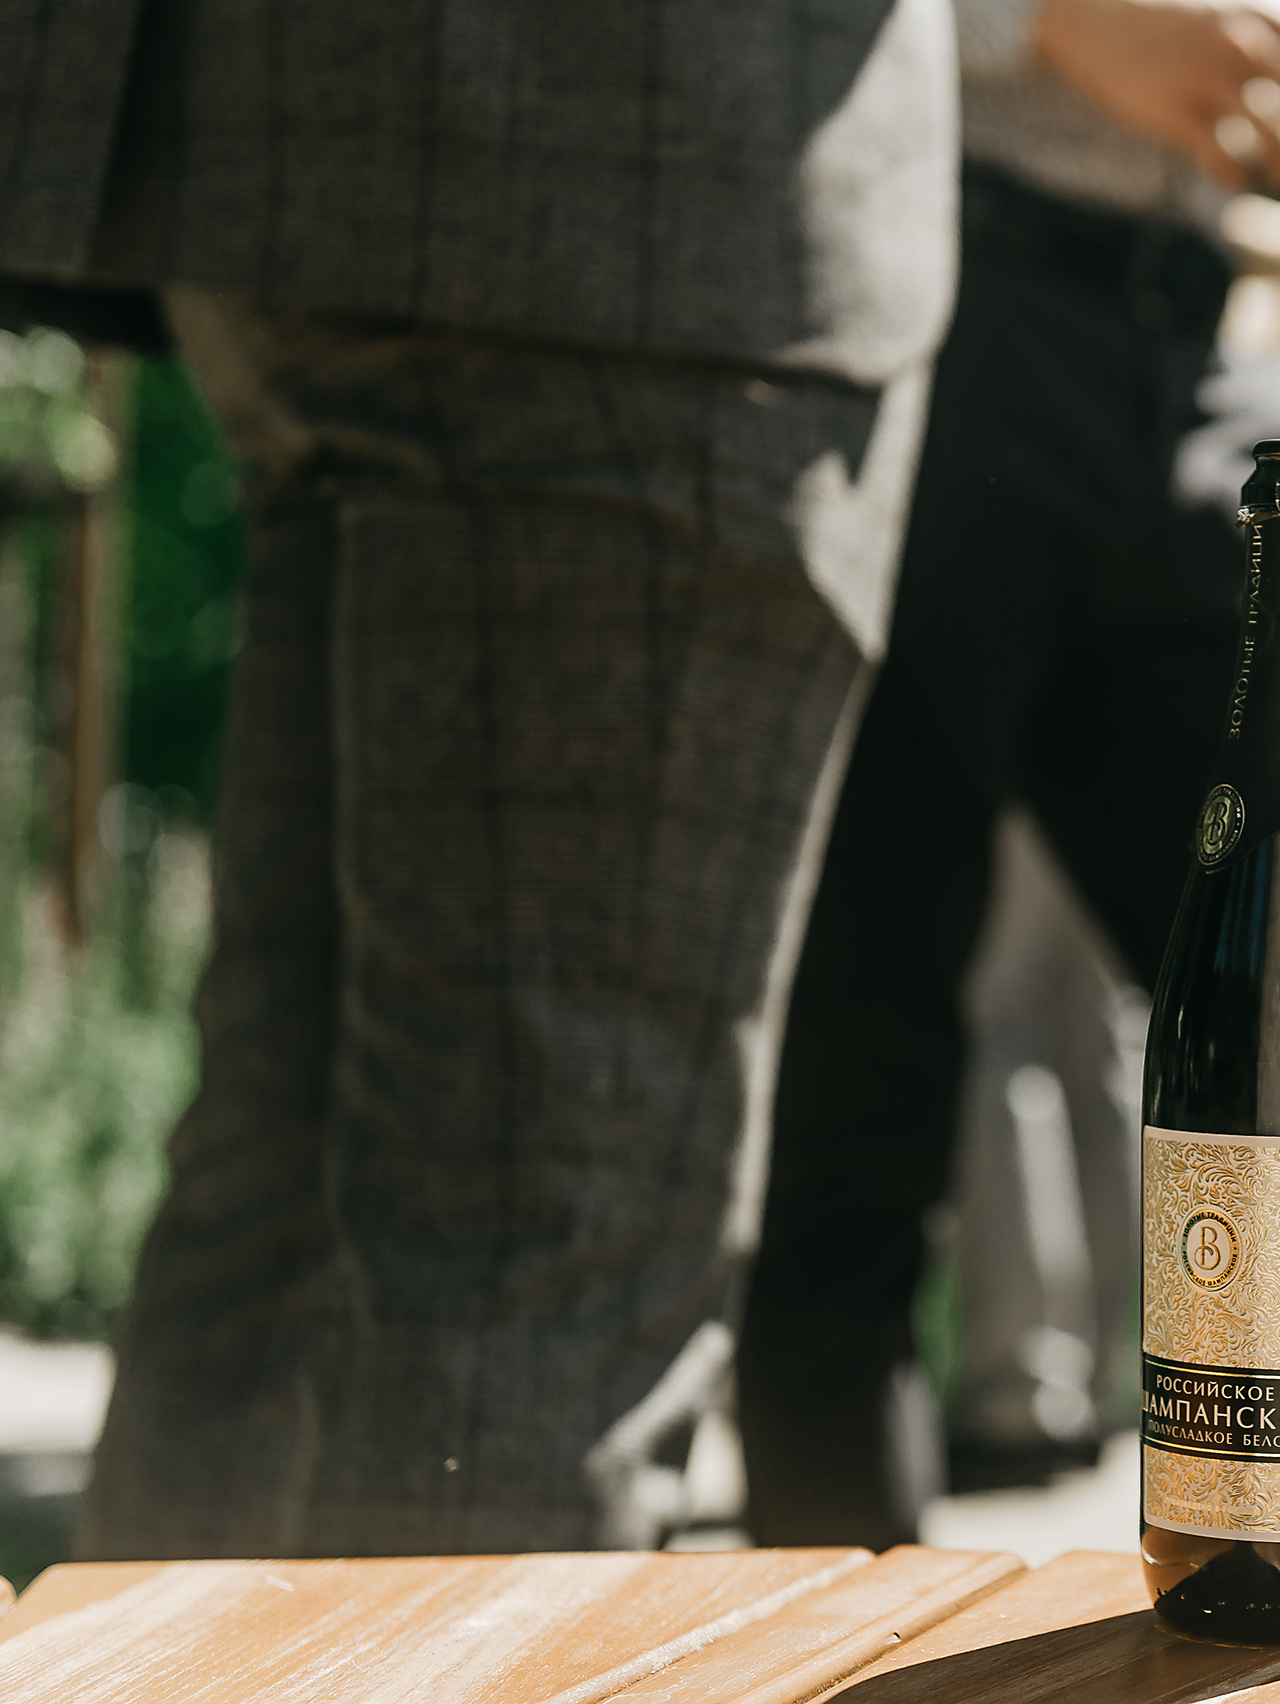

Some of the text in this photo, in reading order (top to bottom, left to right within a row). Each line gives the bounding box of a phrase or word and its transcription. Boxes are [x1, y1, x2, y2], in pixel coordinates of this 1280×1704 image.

[1229, 635, 1256, 740] ЗОЛОТЫЕ
[1207, 1211, 1238, 1243] ТРАДИЦИИ
[1156, 1373, 1275, 1402] РОССИЙСКОЕ
[1148, 1419, 1234, 1445] ПОЛУСЛАДКОЕ
